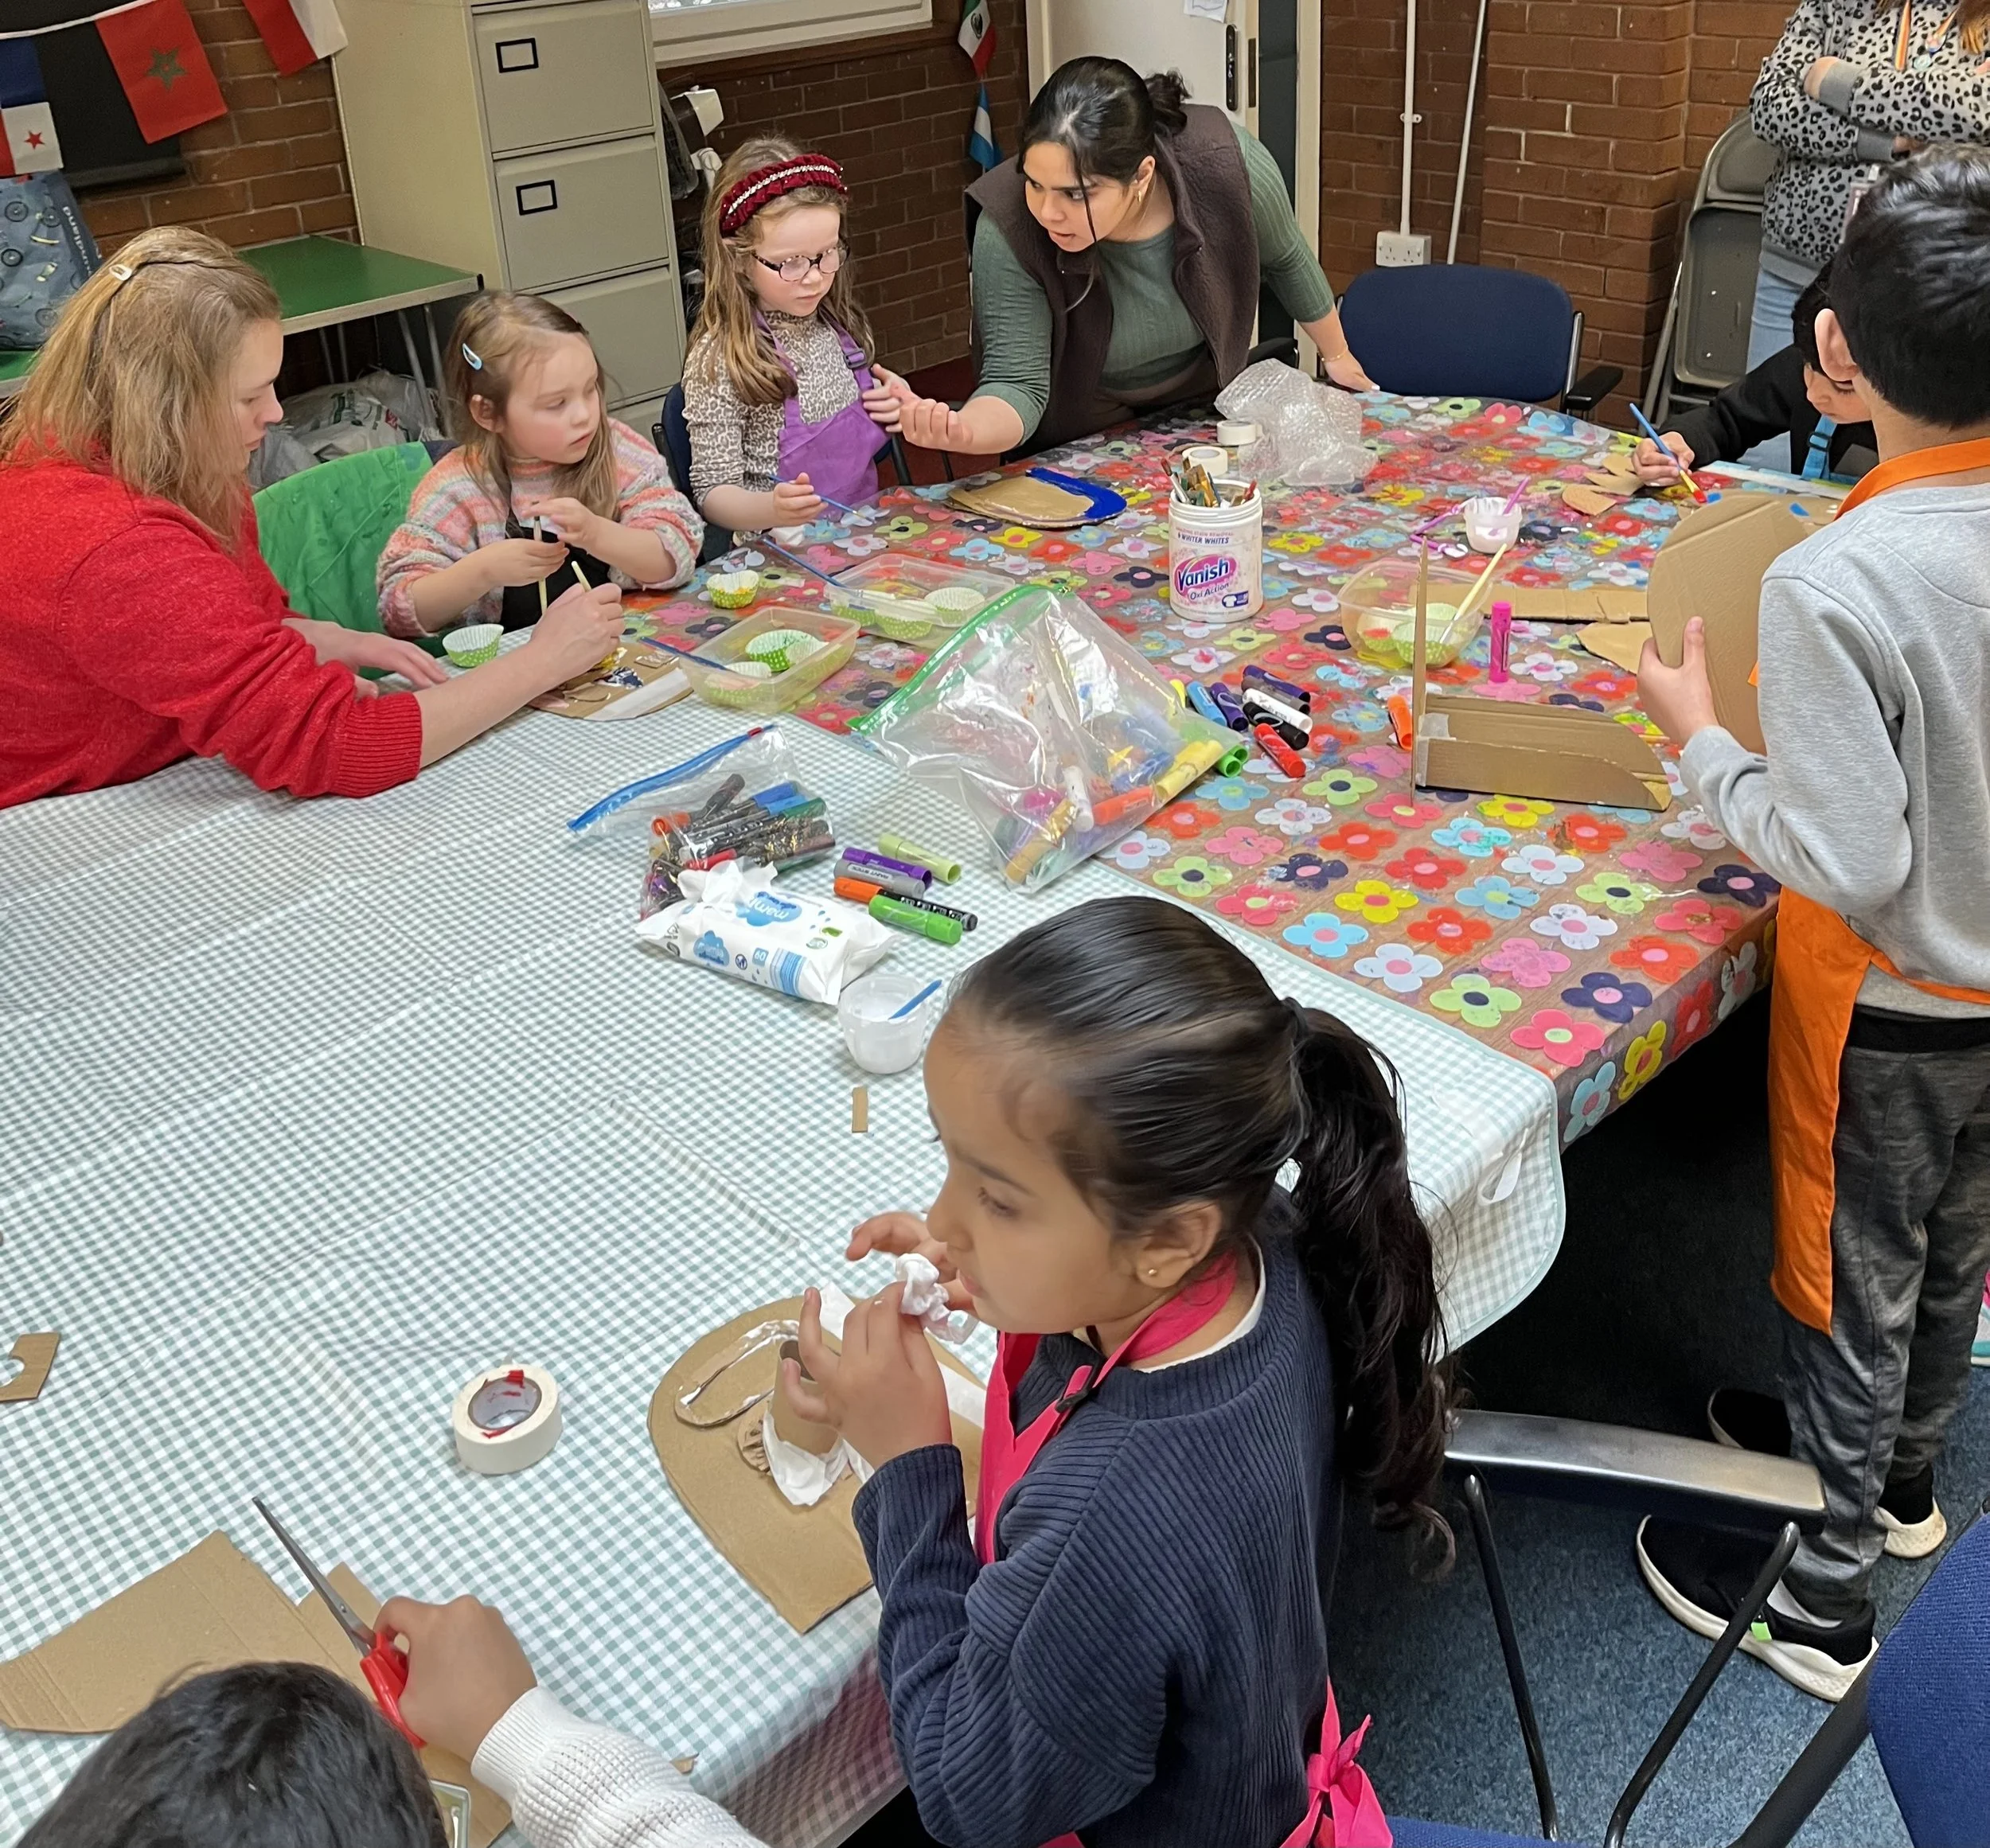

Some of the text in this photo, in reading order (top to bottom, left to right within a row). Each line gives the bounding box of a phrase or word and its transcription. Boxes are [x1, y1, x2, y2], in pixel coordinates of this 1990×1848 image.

[1181, 533, 1202, 544] WHITER
[1178, 559, 1229, 591] Vanish
[1190, 583, 1229, 600] Oxi Action
[748, 898, 790, 919] mami
[755, 949, 766, 961] 60
